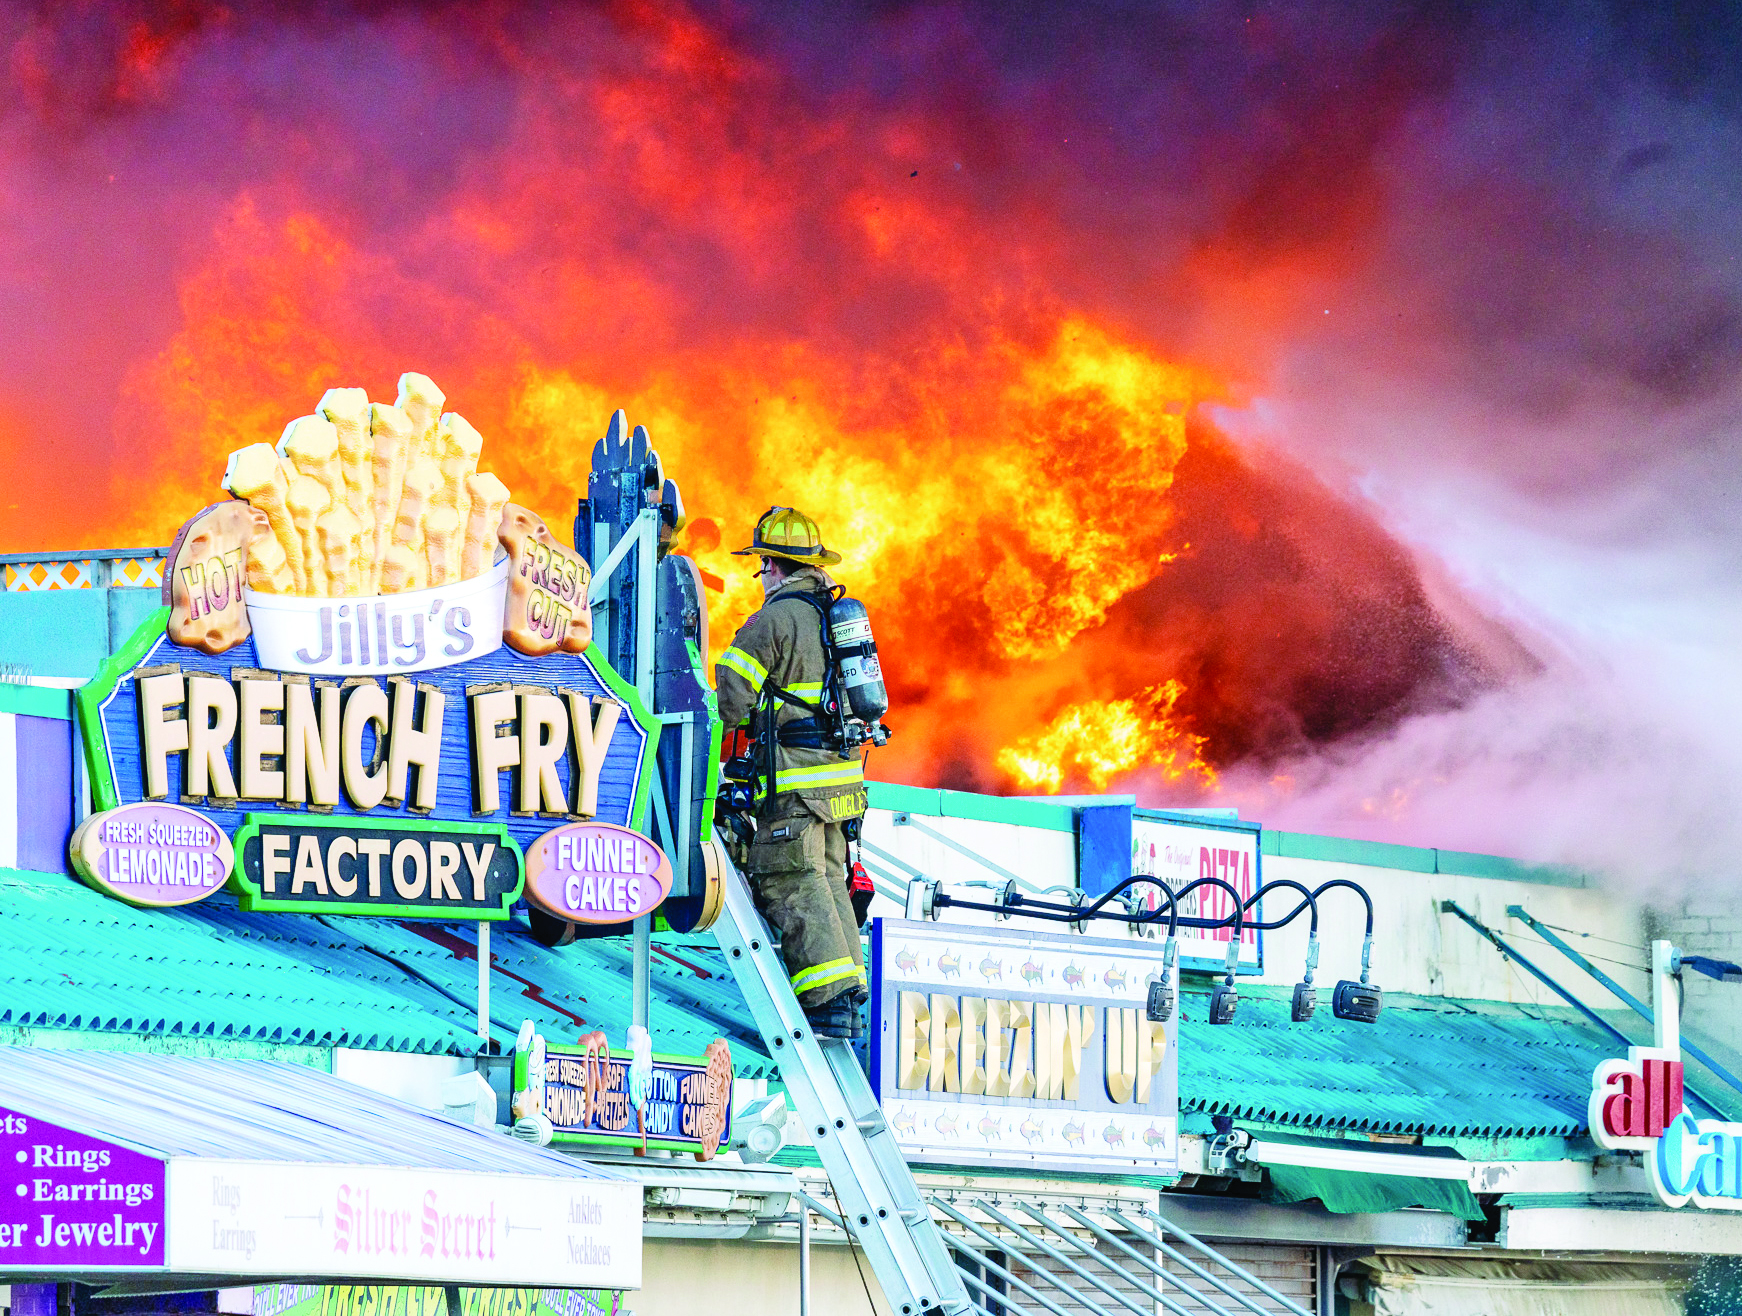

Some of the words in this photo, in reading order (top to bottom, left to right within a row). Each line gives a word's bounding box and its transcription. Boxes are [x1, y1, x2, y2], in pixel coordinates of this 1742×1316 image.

[181, 547, 242, 620] HOT
[520, 535, 591, 611] FRESH
[296, 599, 474, 666] Jilly's
[527, 588, 572, 647] CUT
[837, 627, 855, 636] SCOTT
[141, 673, 445, 811] FRENCH
[474, 691, 621, 818] FRY
[105, 821, 145, 844] FRESH
[149, 824, 213, 848] SQUEEZED
[557, 835, 647, 874] FUNNEL
[107, 848, 215, 887] LEMONADE
[262, 834, 496, 901] FACTORY
[564, 875, 642, 913] CAKES
[1200, 846, 1255, 945] PIZZA
[560, 1059, 587, 1088] SQUEEZED
[1104, 1006, 1168, 1104] UP
[607, 1064, 626, 1092] SOFT
[680, 1073, 720, 1106] FUNNEL
[543, 1085, 587, 1127] LEMONADE
[596, 1090, 630, 1131] PRETZELS
[643, 1102, 675, 1134] CANDY
[682, 1104, 717, 1138] CAKES
[32, 1144, 111, 1173] Rings
[1657, 1112, 1742, 1199] Ca
[32, 1178, 154, 1206] Earrings
[212, 1175, 241, 1216] Rings
[567, 1196, 602, 1226] Anklets
[35, 1213, 158, 1255] Jewelry
[212, 1219, 257, 1261] Earrings
[333, 1183, 411, 1257] Silver
[420, 1189, 497, 1262] Secret
[566, 1235, 611, 1267] Necklaces
